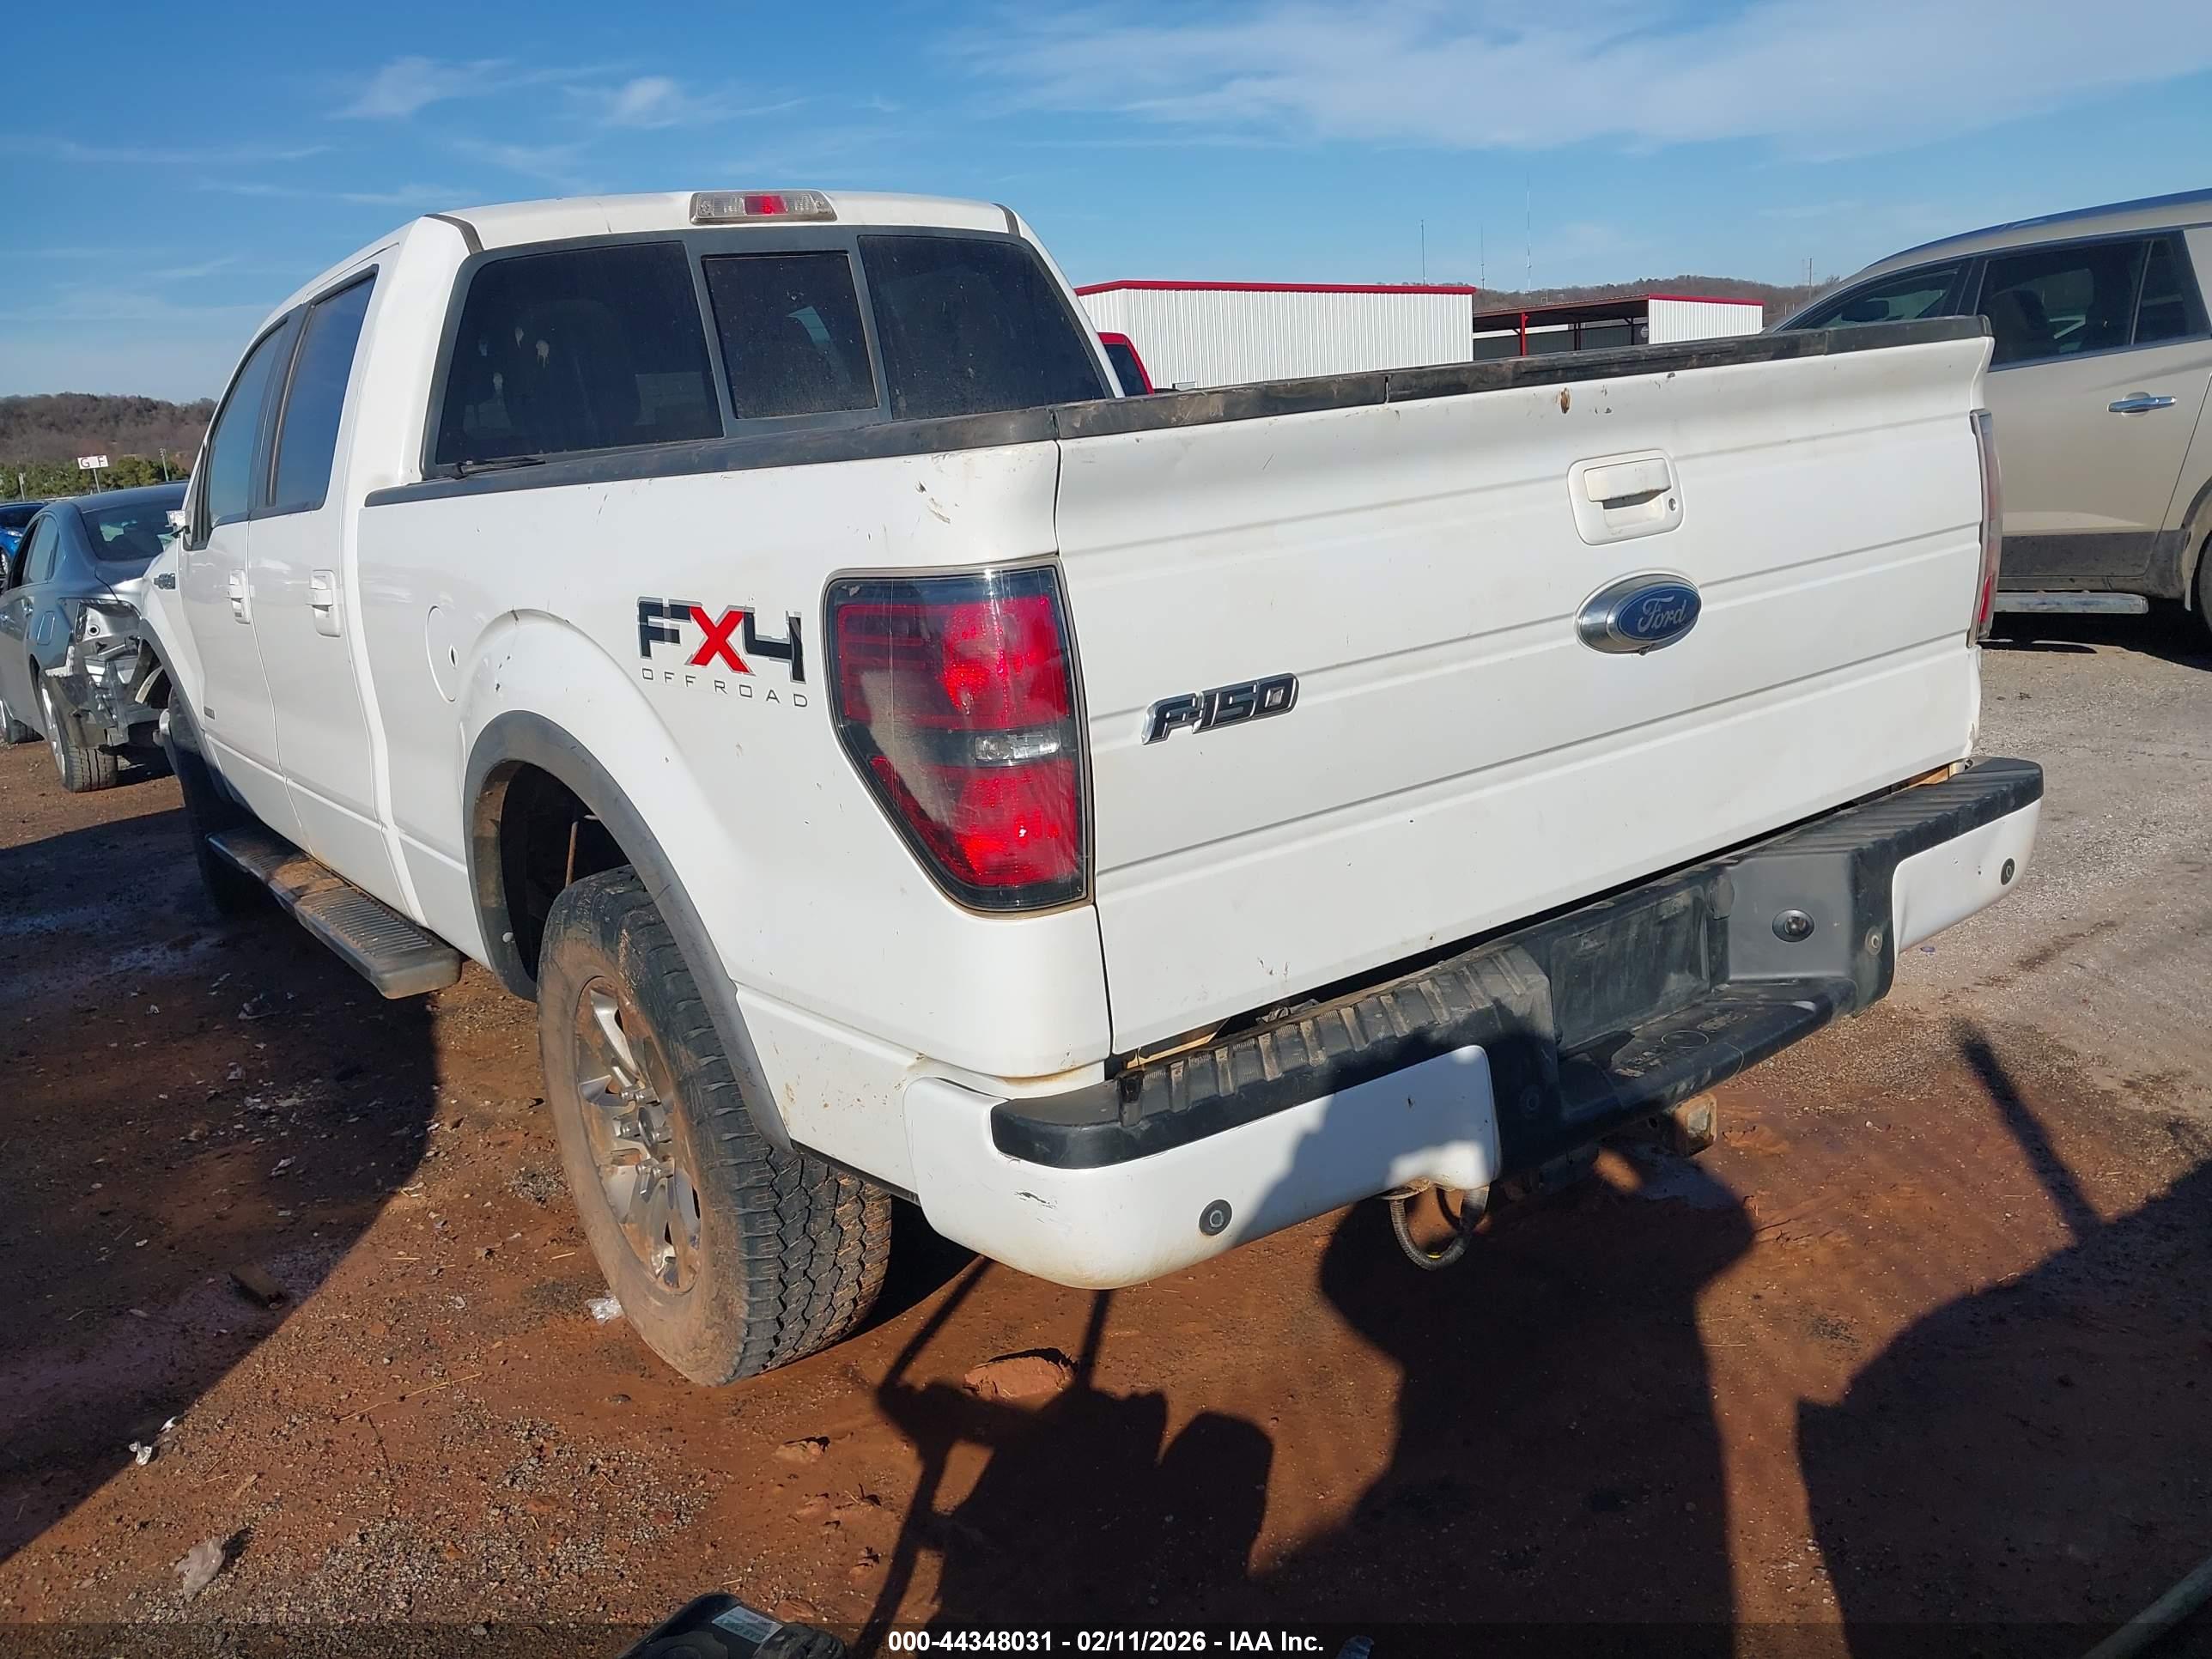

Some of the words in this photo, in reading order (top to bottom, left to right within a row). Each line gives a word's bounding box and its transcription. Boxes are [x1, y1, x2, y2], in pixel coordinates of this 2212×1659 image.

[81, 457, 90, 468] G
[97, 455, 104, 467] F
[636, 596, 806, 684] FX4
[1637, 594, 1687, 633] Ford
[1141, 672, 1300, 745] F-150
